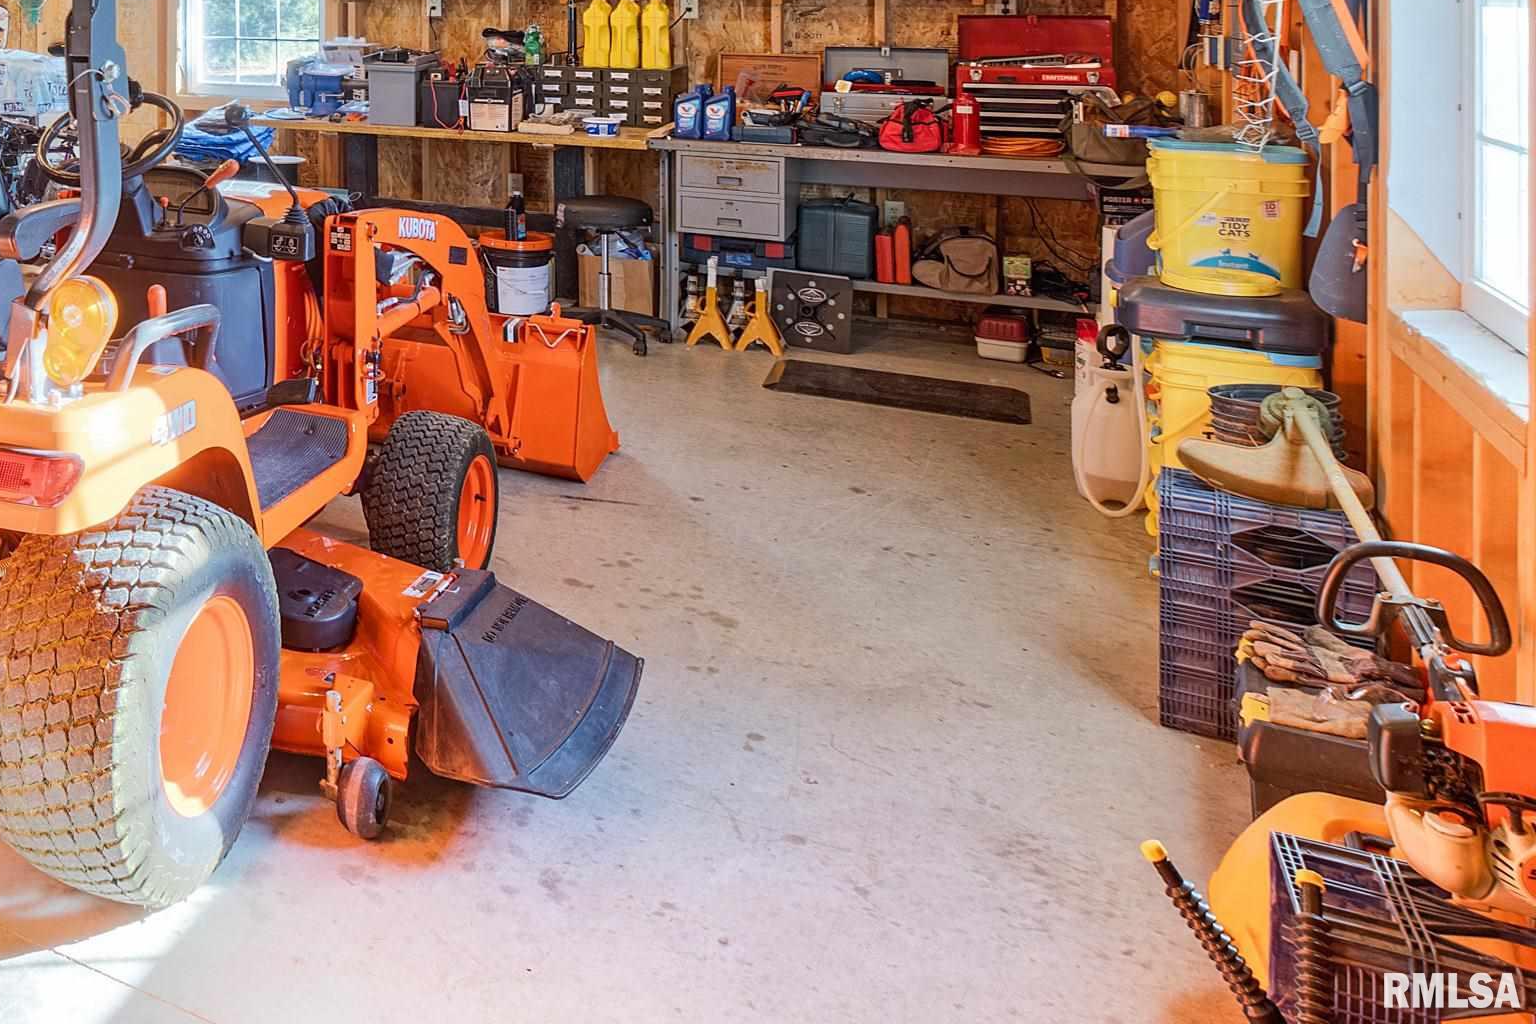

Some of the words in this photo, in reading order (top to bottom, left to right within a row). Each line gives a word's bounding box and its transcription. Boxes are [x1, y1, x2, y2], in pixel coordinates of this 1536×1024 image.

[399, 216, 437, 241] KUBOTA
[1219, 222, 1249, 230] TIDY
[1218, 229, 1251, 238] CATS
